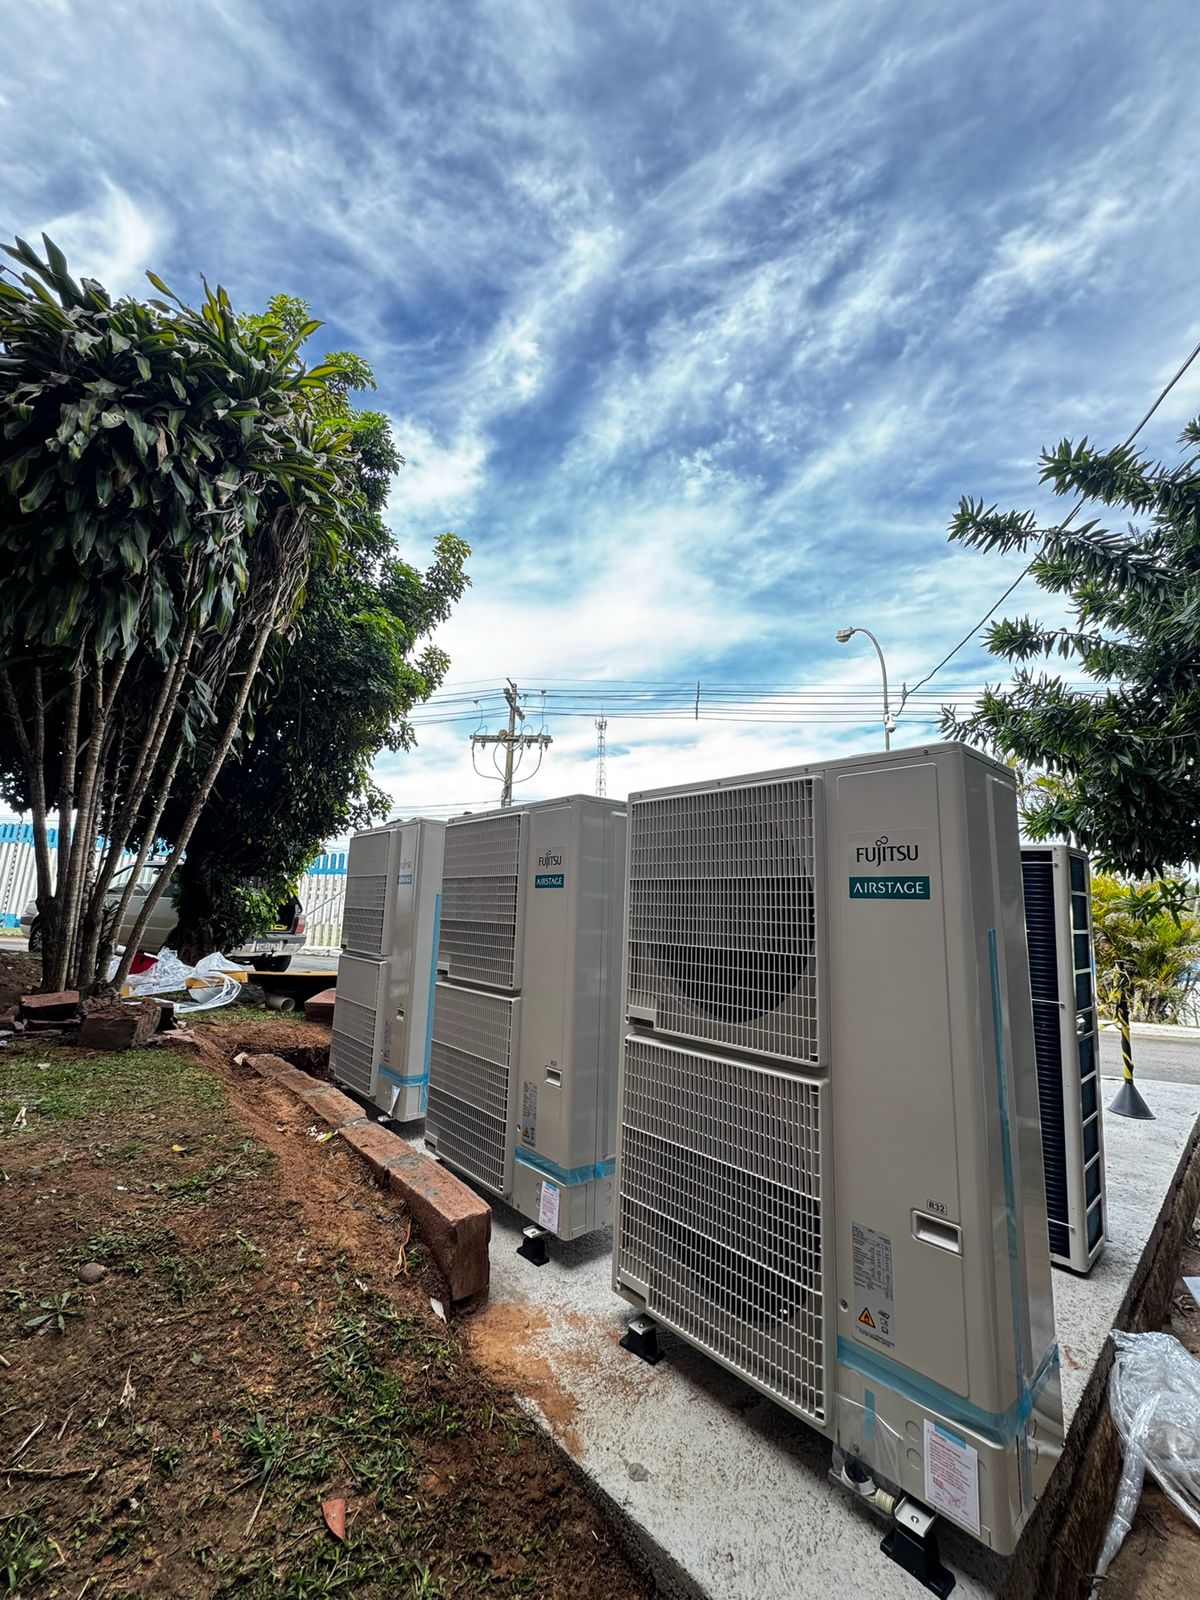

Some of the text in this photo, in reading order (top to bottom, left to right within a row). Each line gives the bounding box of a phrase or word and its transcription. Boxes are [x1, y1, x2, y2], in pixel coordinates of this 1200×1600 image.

[856, 836, 919, 867] FUJITSU
[538, 850, 562, 868] FUJITSU
[537, 877, 562, 886] AIRSTAGE
[853, 882, 925, 894] AIRSTAGE
[928, 1201, 945, 1213] R32
